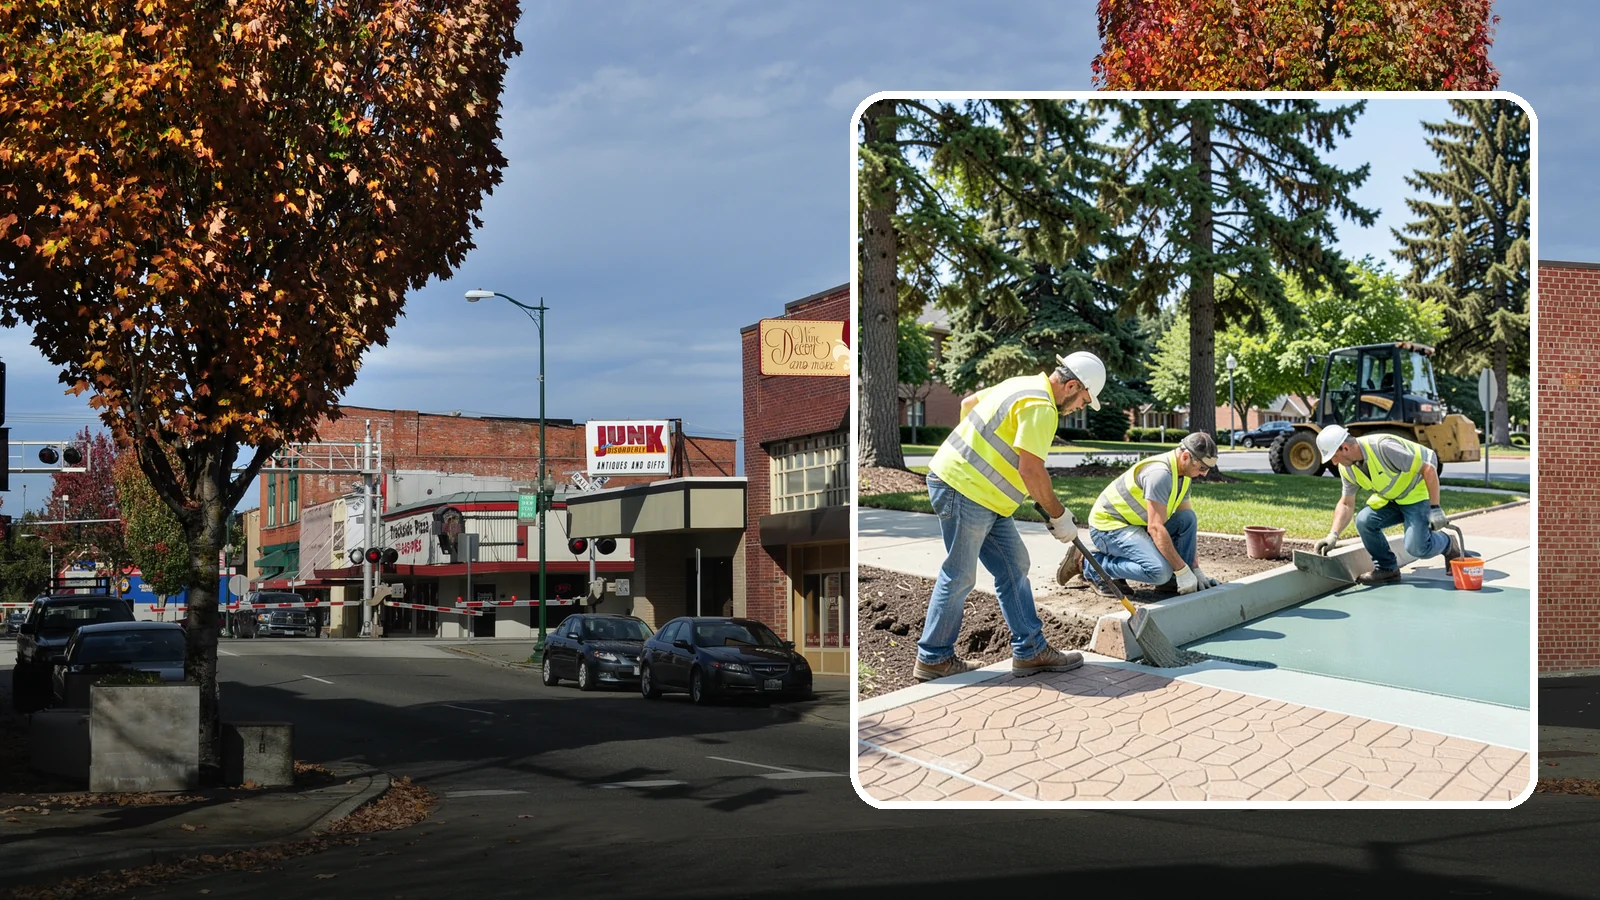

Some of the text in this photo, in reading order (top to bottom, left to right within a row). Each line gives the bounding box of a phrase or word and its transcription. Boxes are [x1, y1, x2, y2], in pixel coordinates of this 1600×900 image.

[765, 327, 831, 365] Decor
[595, 425, 664, 457] JUNK
[607, 446, 646, 454] DISORDERLY
[597, 460, 665, 470] ANTIQUES AND GIFTS
[414, 519, 429, 535] Pizza
